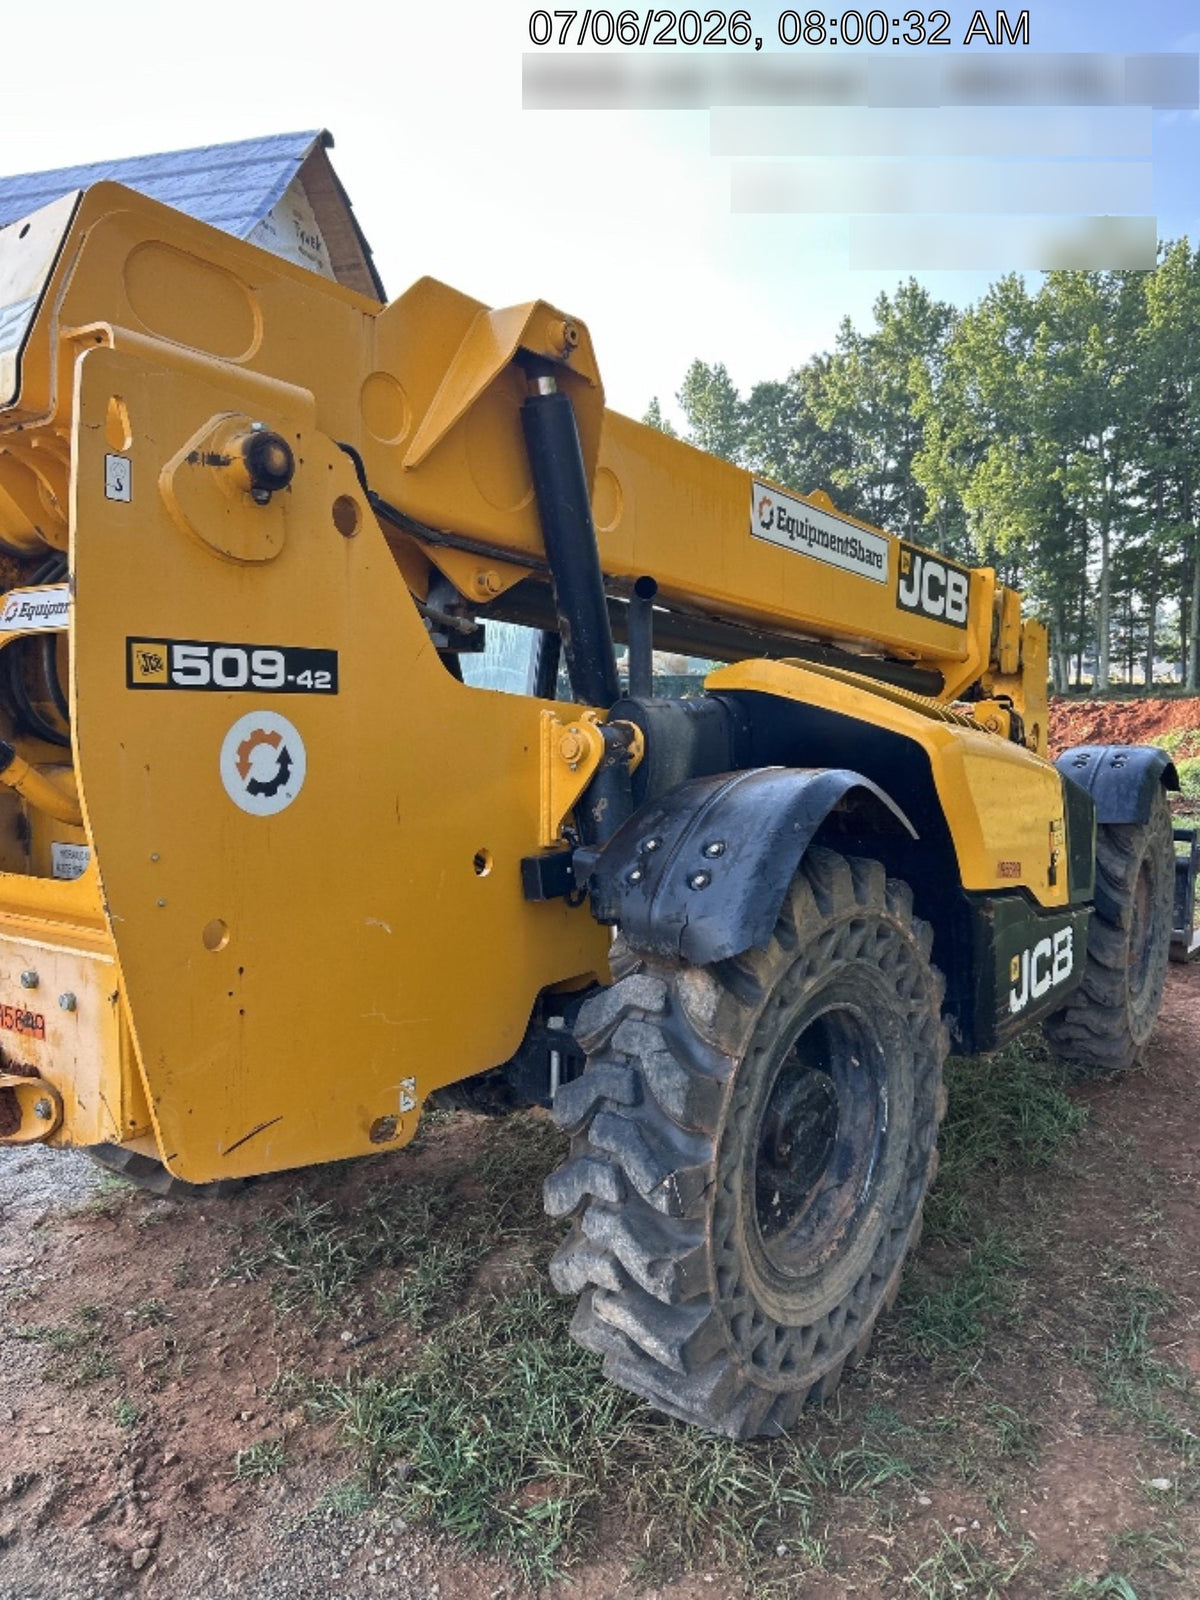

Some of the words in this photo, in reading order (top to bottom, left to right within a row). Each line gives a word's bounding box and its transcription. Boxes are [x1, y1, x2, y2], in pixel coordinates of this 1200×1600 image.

[777, 506, 883, 569] EquipmentShare
[900, 555, 968, 623] JCB
[171, 644, 332, 689] 509-42
[1008, 926, 1073, 1013] JCB
